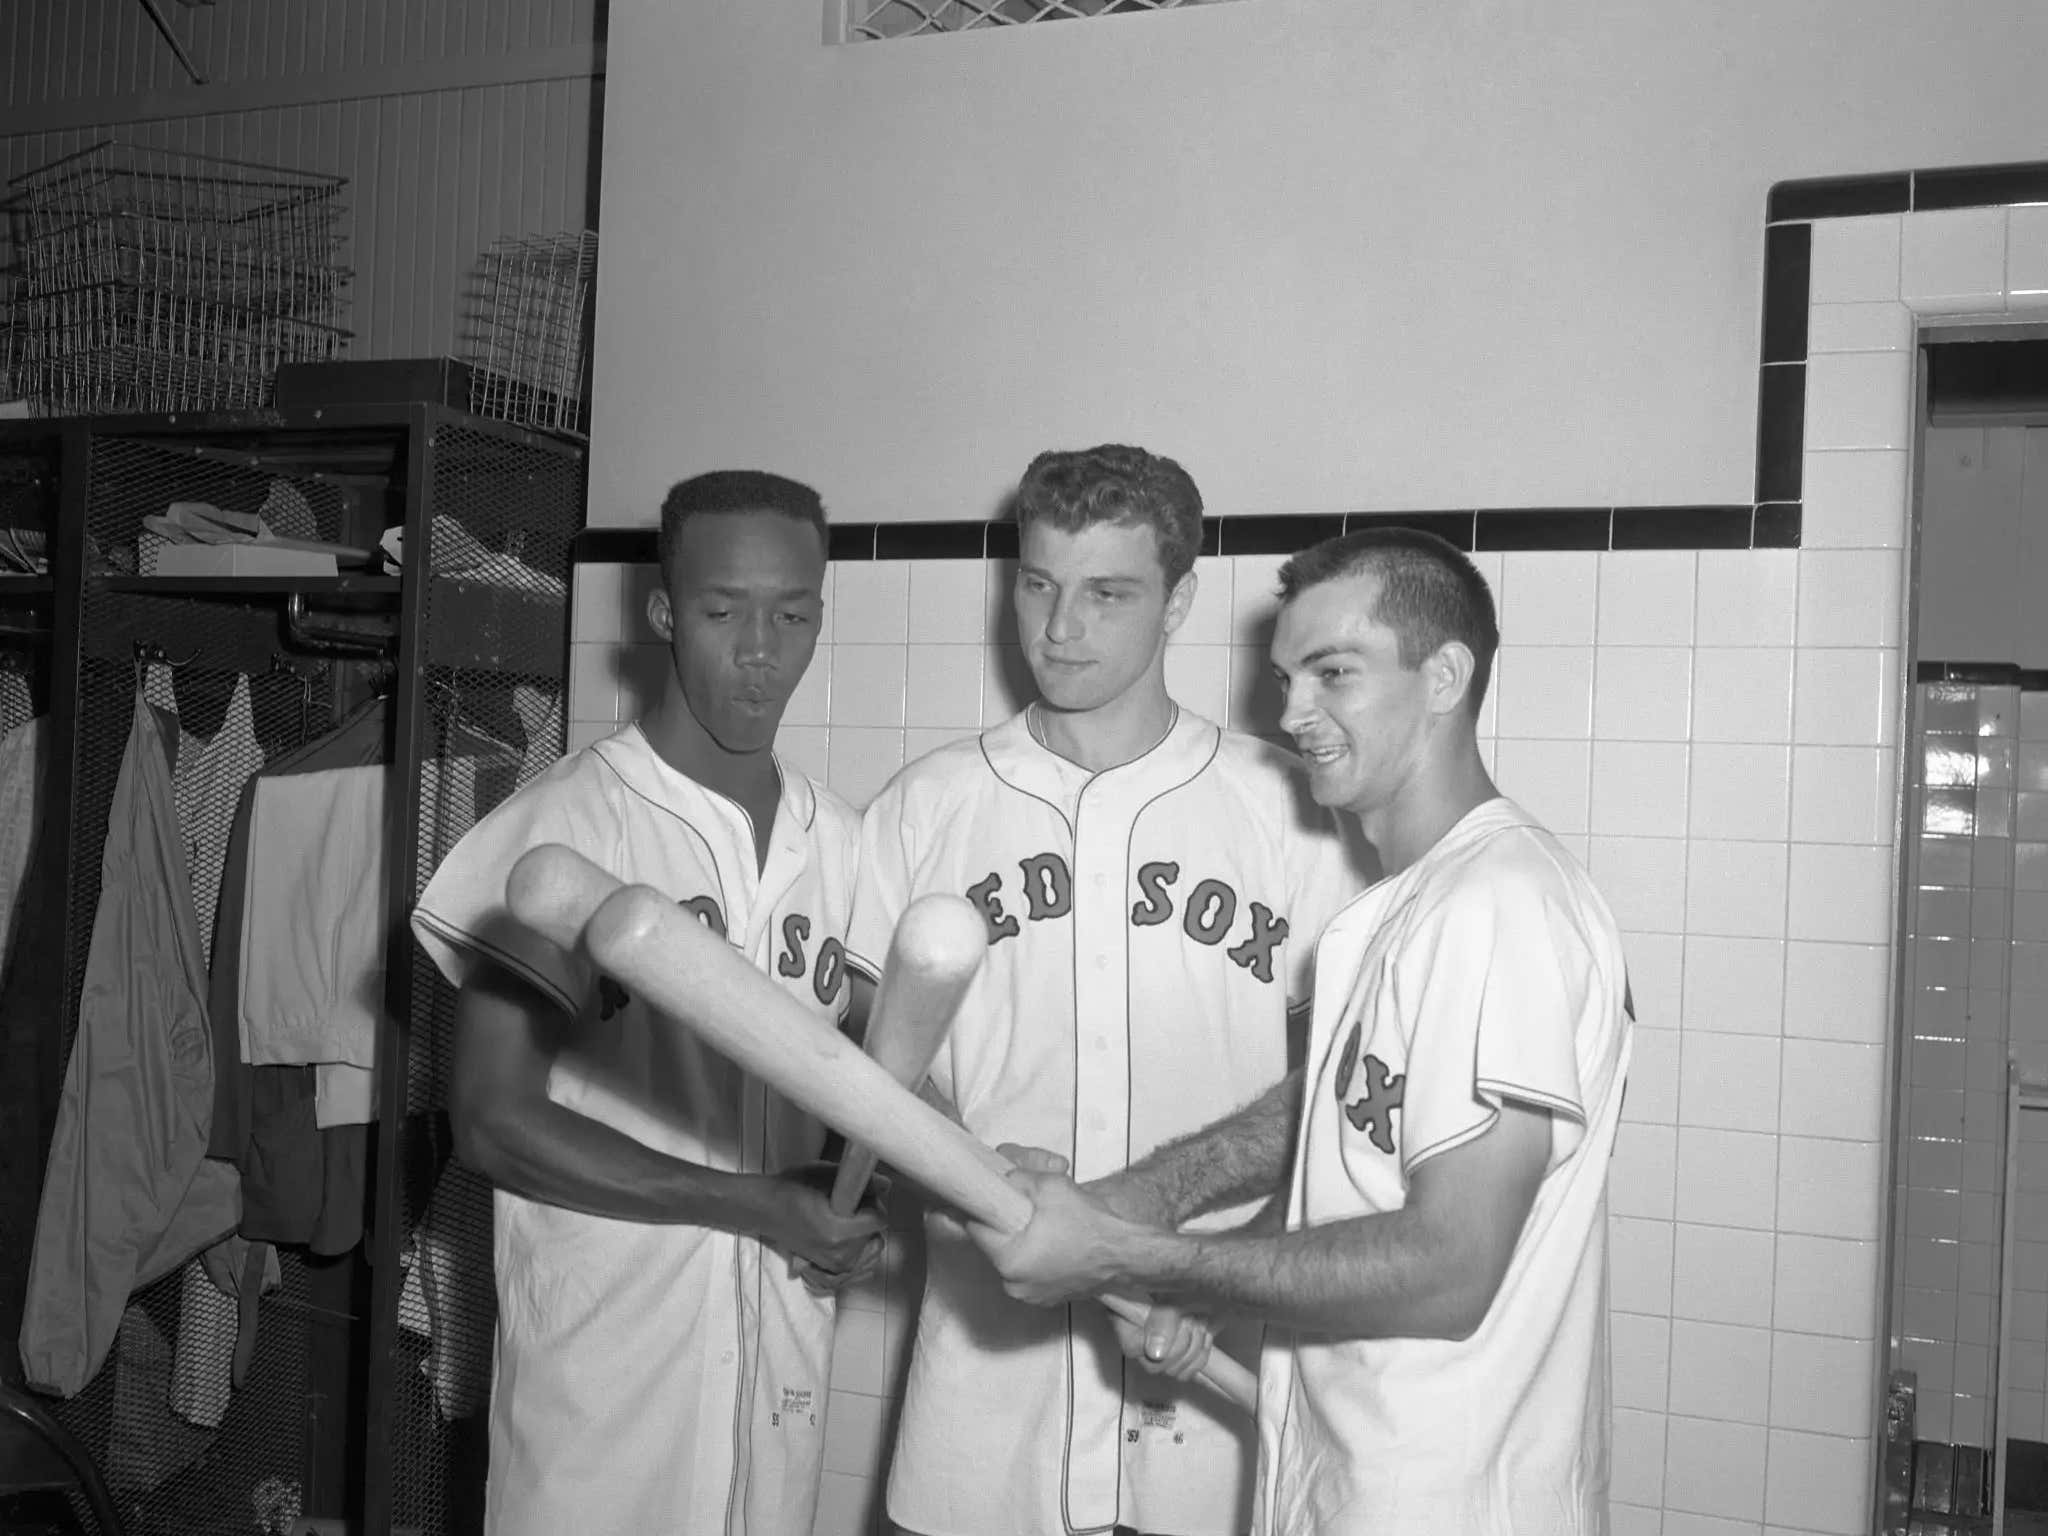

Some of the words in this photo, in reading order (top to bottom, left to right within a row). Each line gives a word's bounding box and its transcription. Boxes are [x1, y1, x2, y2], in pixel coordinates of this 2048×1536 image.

[778, 913, 846, 1005] SO
[967, 853, 1072, 945] ED
[1132, 861, 1289, 983] SOX
[1335, 1021, 1406, 1154] OX
